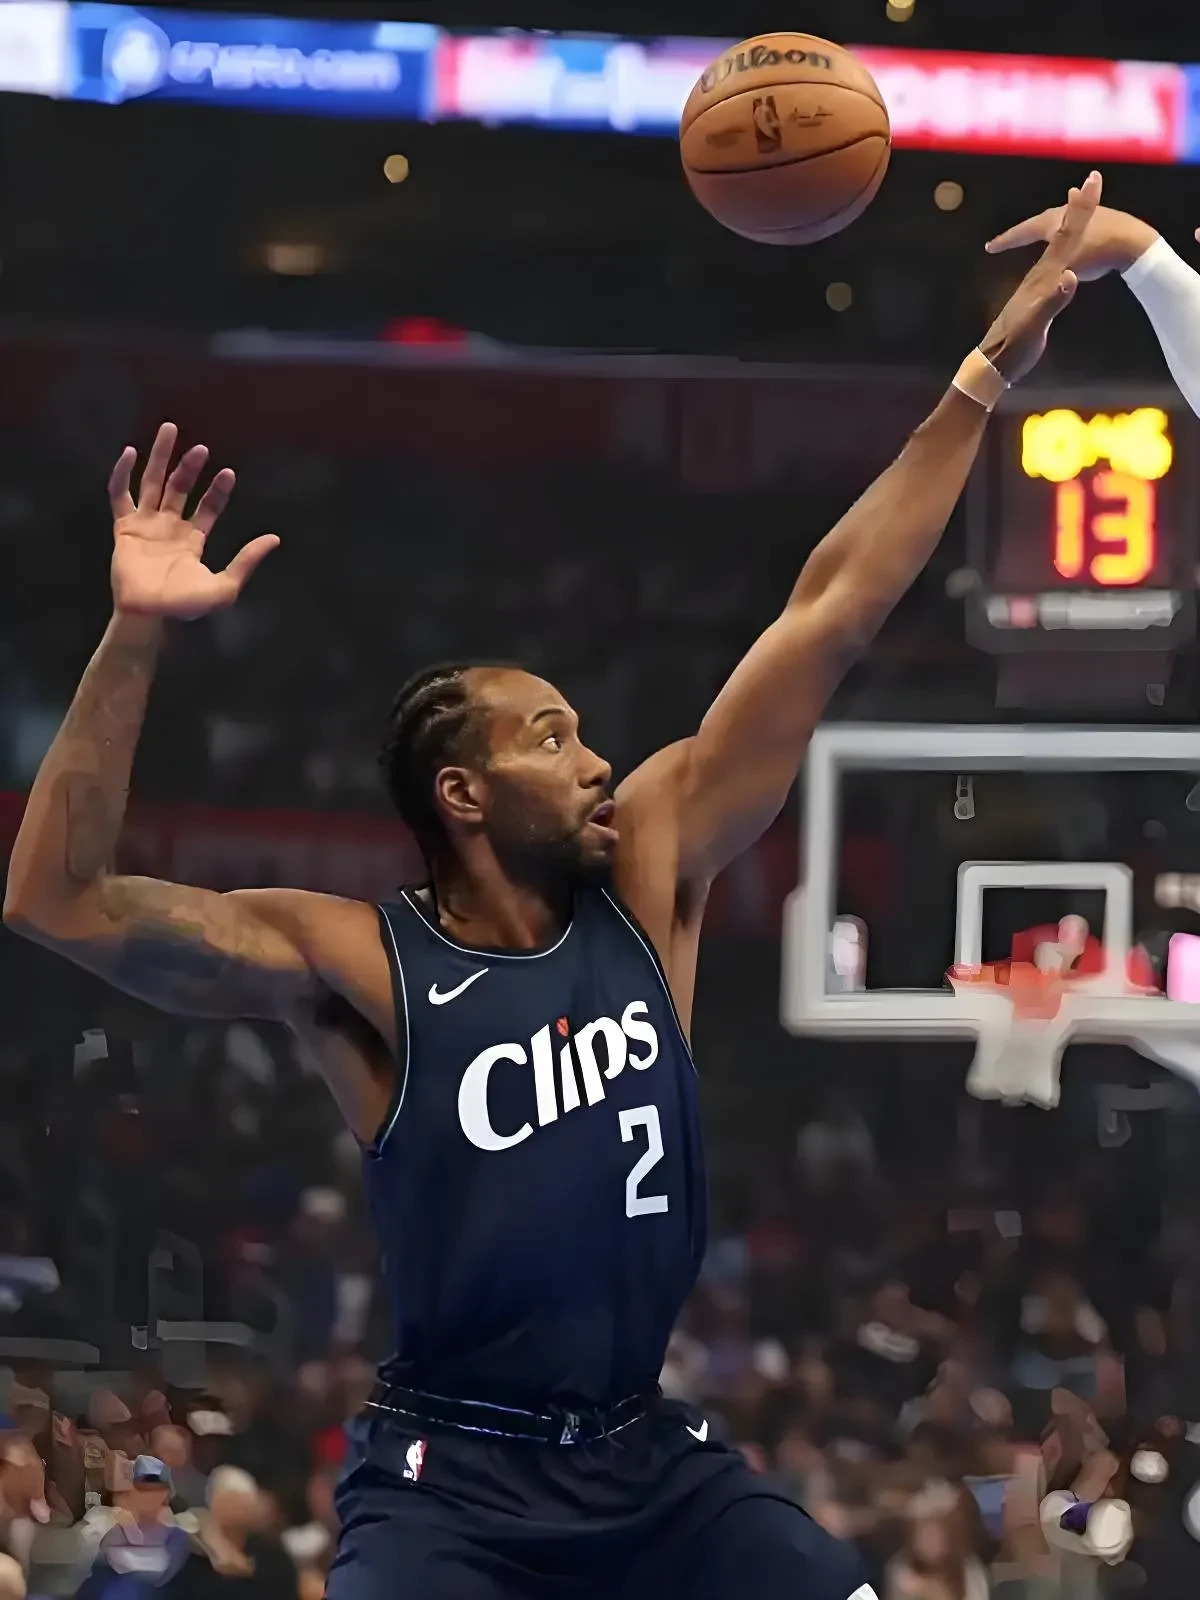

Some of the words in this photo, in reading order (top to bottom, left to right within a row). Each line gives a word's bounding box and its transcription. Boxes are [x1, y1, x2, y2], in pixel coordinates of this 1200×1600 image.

[1053, 472, 1156, 585] 13
[457, 1000, 659, 1151] Clips
[618, 1104, 669, 1218] 2
